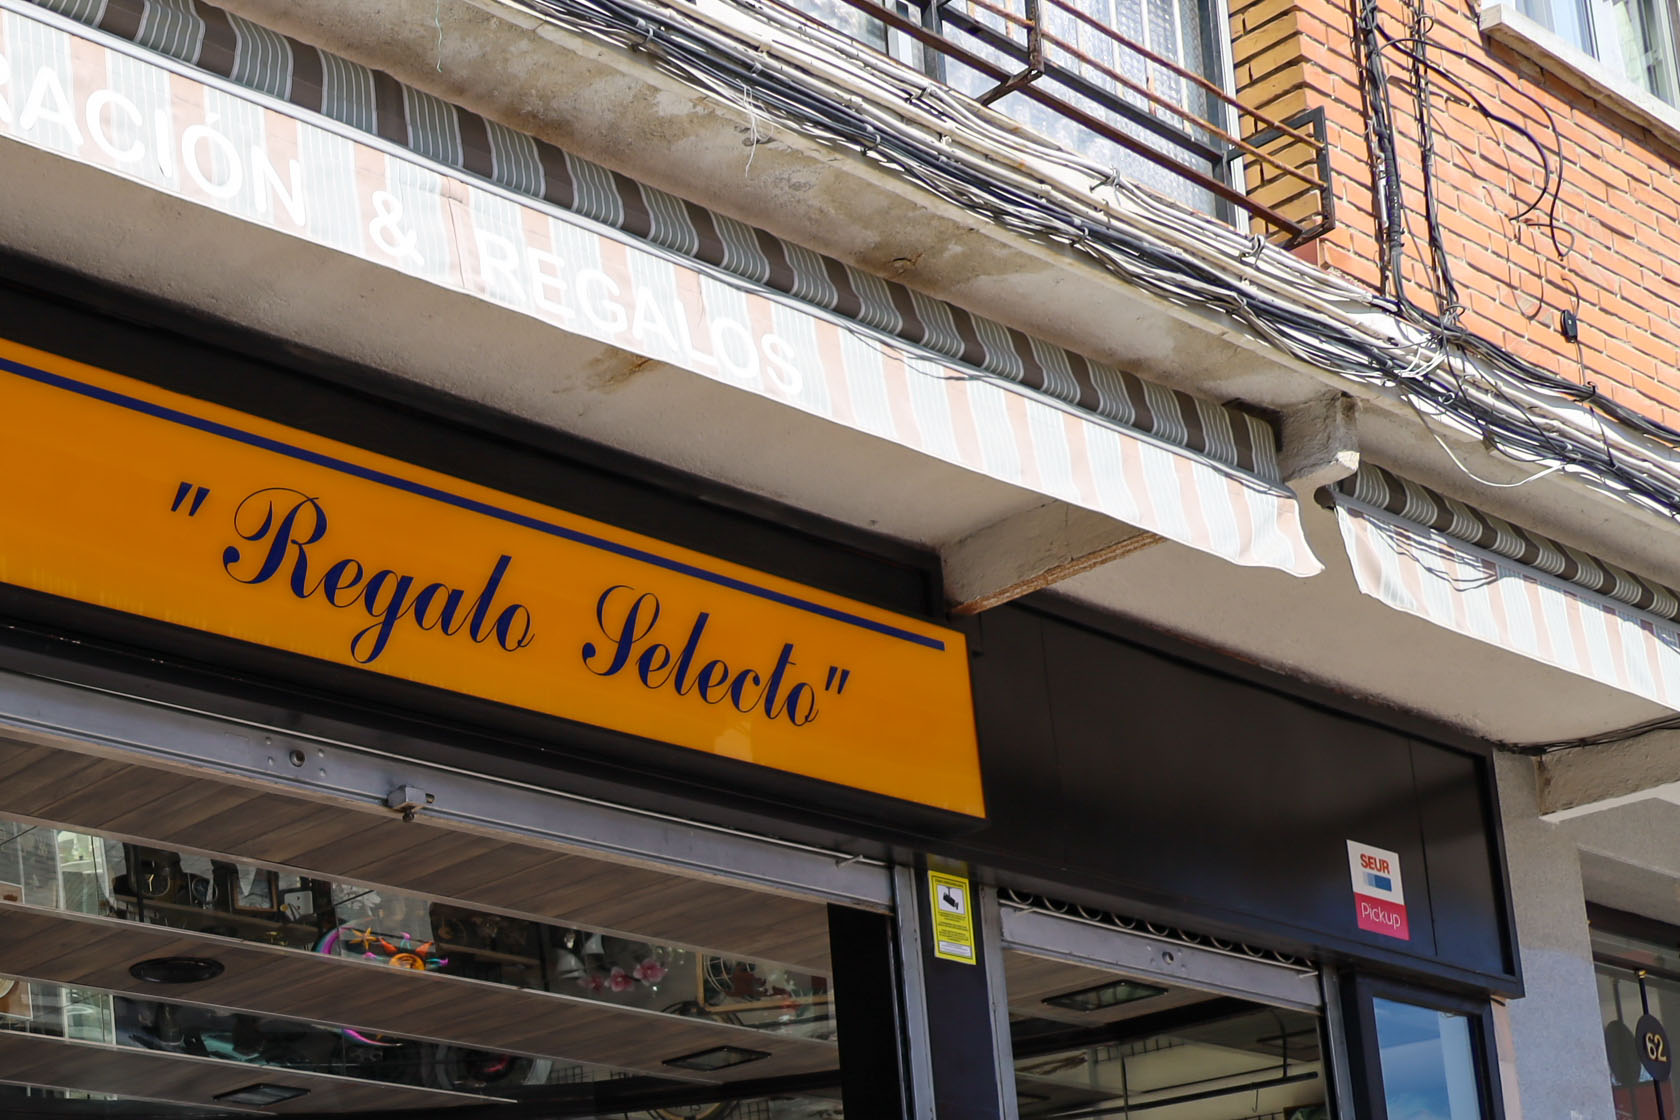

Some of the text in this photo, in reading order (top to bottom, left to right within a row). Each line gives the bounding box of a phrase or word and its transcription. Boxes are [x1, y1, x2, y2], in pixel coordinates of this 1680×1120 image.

[369, 190, 425, 267] &
[476, 229, 804, 395] REGALOS
[1359, 852, 1391, 875] SEUR
[1360, 901, 1402, 930] Pickup
[1644, 1032, 1668, 1062] 62
